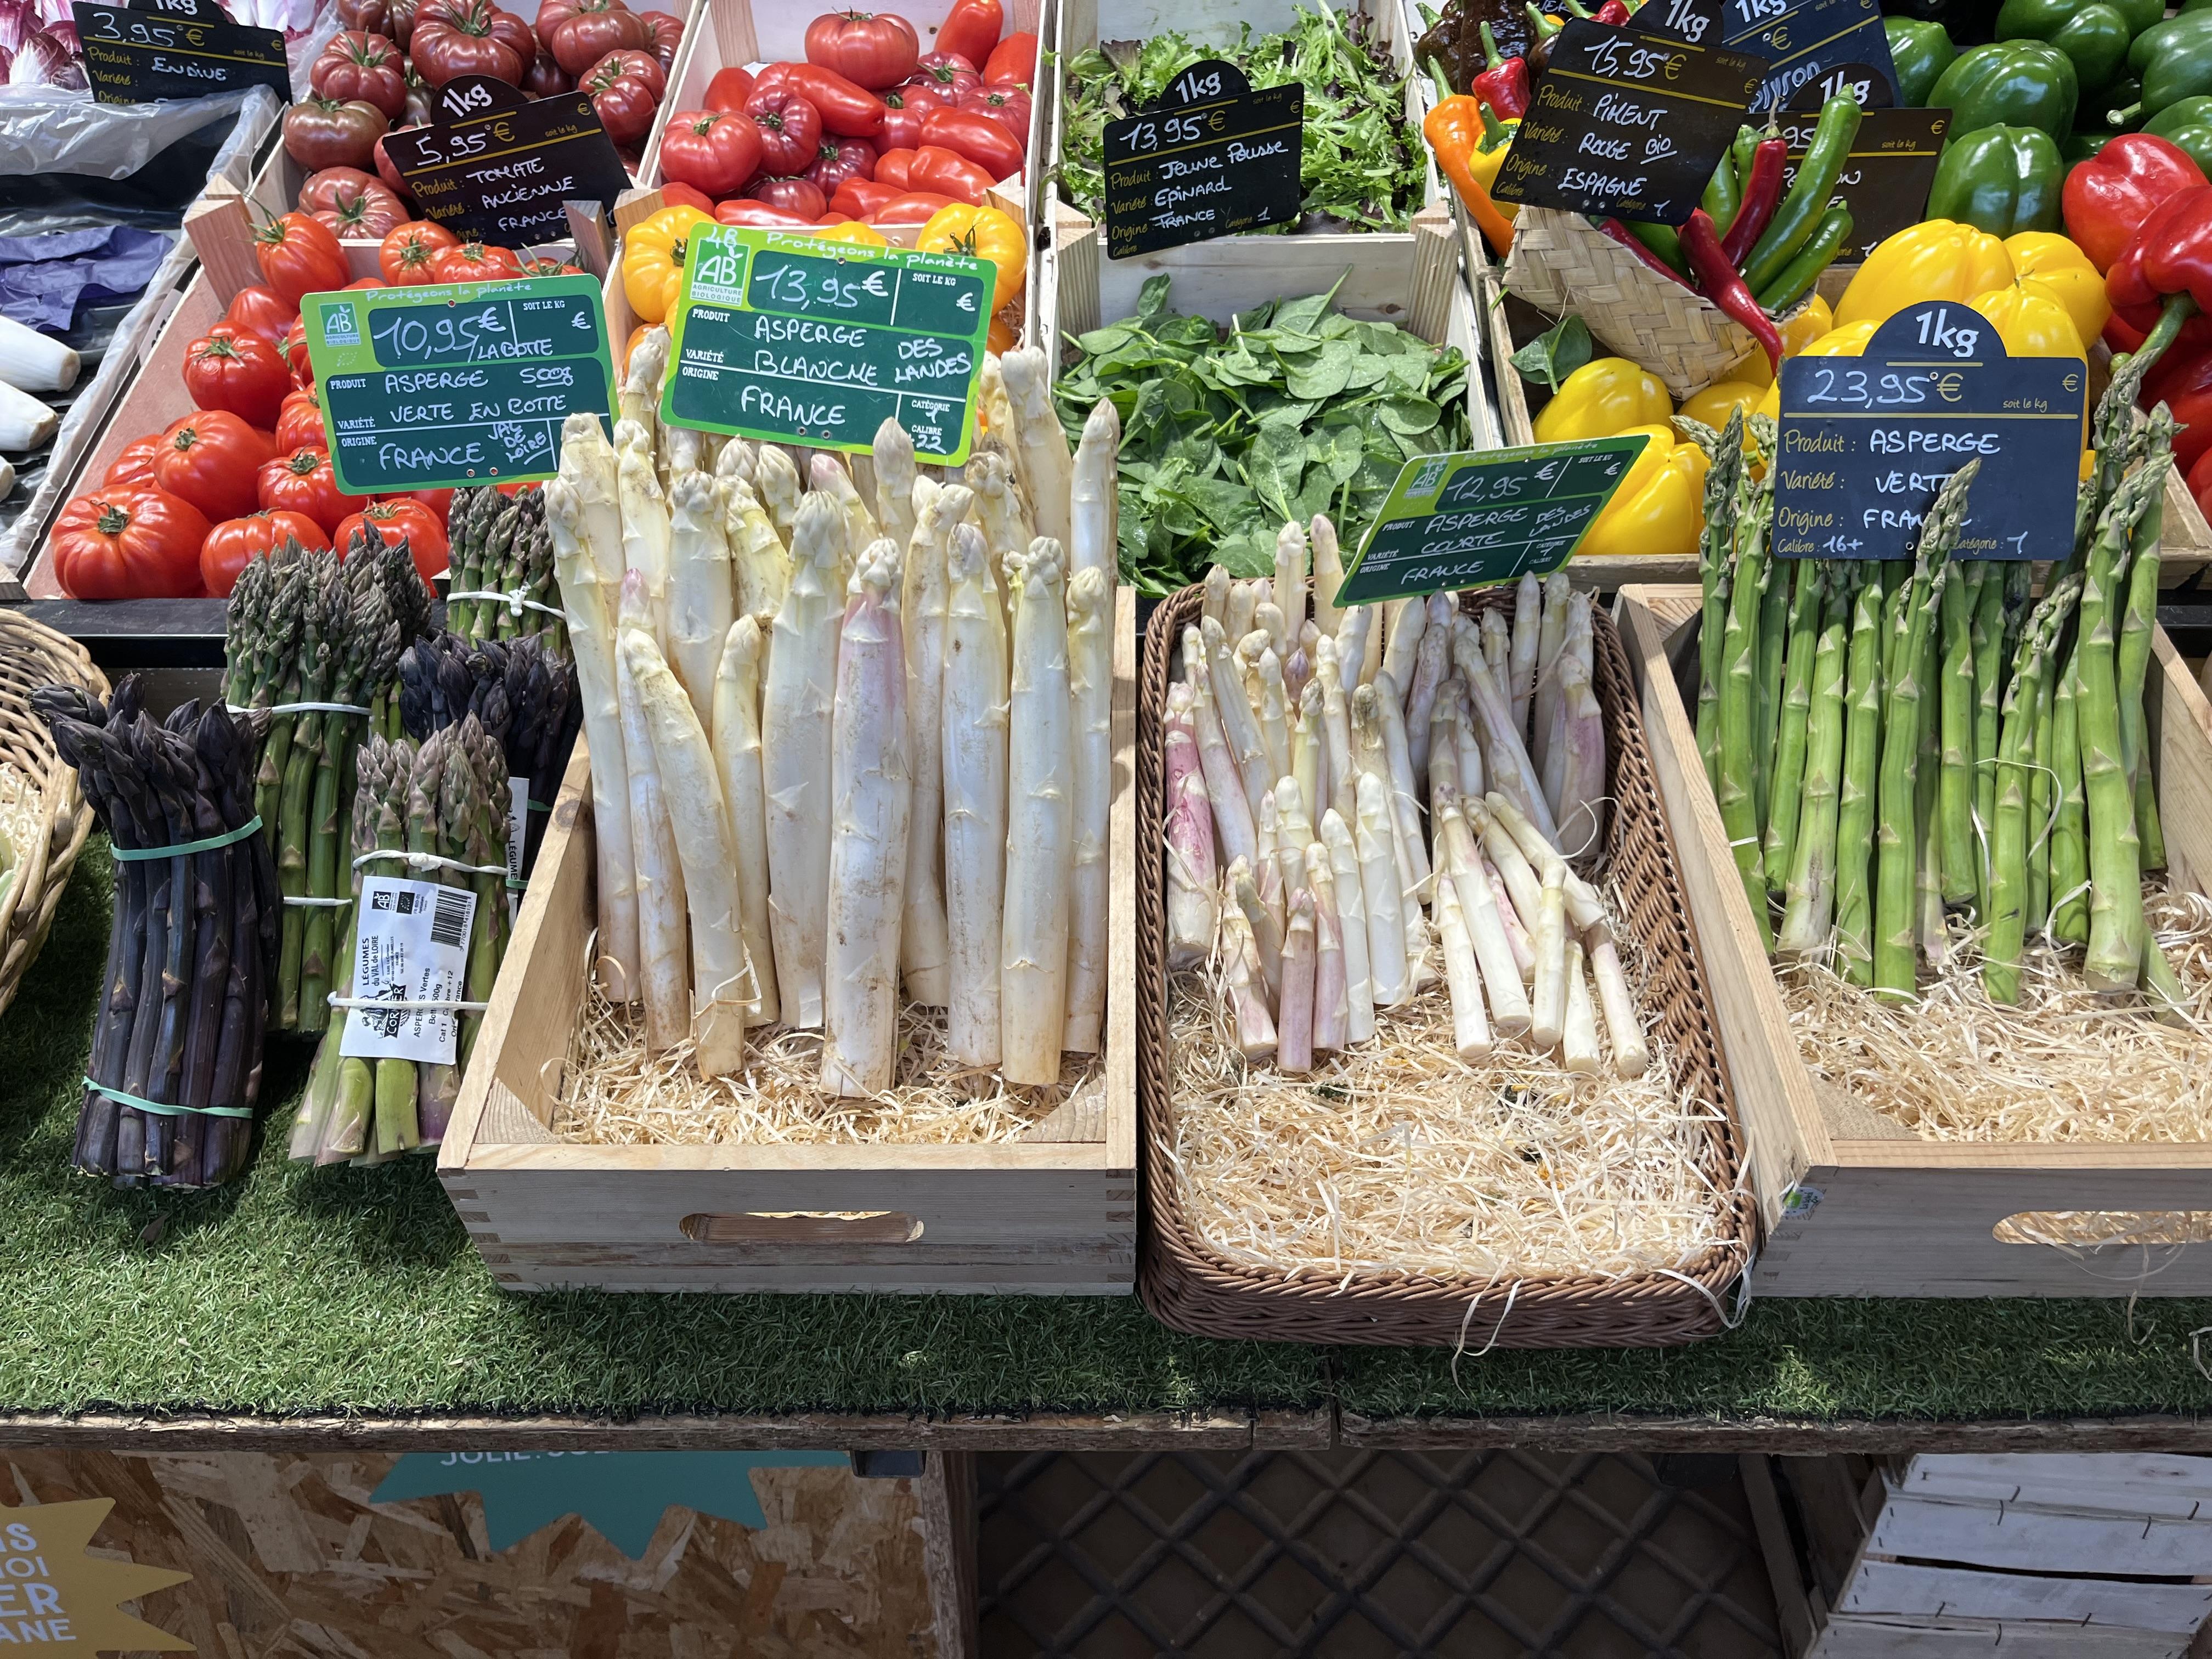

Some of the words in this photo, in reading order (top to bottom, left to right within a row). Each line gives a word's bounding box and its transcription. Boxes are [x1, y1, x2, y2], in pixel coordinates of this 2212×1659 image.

[1664, 0, 1711, 43] 1kg
[1175, 71, 1221, 103] 1kg
[442, 84, 493, 117] 1kg
[466, 157, 545, 184] TOMATE
[1556, 168, 1647, 197] ESPAGNE
[1257, 207, 1271, 222] 1
[883, 247, 899, 261] la
[697, 255, 737, 285] AB
[912, 273, 930, 284] SOIT
[932, 275, 943, 285] LE
[943, 276, 956, 287] KG
[458, 285, 471, 296] la
[692, 291, 741, 303] BIOLOGIQUE
[693, 284, 742, 296] AGRICULTURE
[523, 302, 541, 311] SOIT
[542, 301, 553, 309] LE
[554, 300, 566, 308] KG
[956, 292, 975, 311] €
[326, 313, 352, 334] AB
[571, 312, 591, 330] €
[692, 309, 730, 323] PRODUIT
[754, 315, 867, 347] ASPERGE
[1915, 308, 1979, 358] 1kg
[686, 348, 724, 363] VARIÉTÉ
[898, 338, 943, 359] DES
[682, 366, 719, 381] ORIGINE
[894, 353, 972, 383] LANDES
[330, 378, 366, 390] PRODUIT
[385, 369, 489, 394] ASPERGE
[2062, 374, 2079, 392] €
[390, 402, 454, 424] VERTE
[469, 403, 501, 421] EN
[741, 385, 846, 425] FRANCE
[911, 399, 950, 412] CATÉGORIE
[2002, 399, 2021, 409] soit
[2022, 398, 2032, 409] le
[2034, 398, 2048, 414] kg
[338, 416, 376, 430] VARIÉTÉ
[911, 425, 943, 436] CALIBRE
[341, 436, 377, 447] ORIGINE
[1869, 430, 2000, 454] ASPERGE
[379, 442, 486, 471] FRANCE
[1604, 461, 1621, 476] €
[1382, 521, 1415, 532] PRODUIT
[1425, 507, 1528, 535] ASPERGE
[1536, 506, 1566, 524] DES
[1528, 504, 1592, 537] LANDES
[1421, 531, 1506, 555] COURTE
[2006, 531, 2028, 555] 1
[1359, 563, 1391, 574] ORIGINE
[1401, 561, 1485, 585] FRANCE
[377, 894, 390, 909] AB
[361, 938, 369, 986] LÉGUMES
[371, 955, 377, 963] de
[373, 978, 380, 986] du
[420, 968, 431, 992] Vertes
